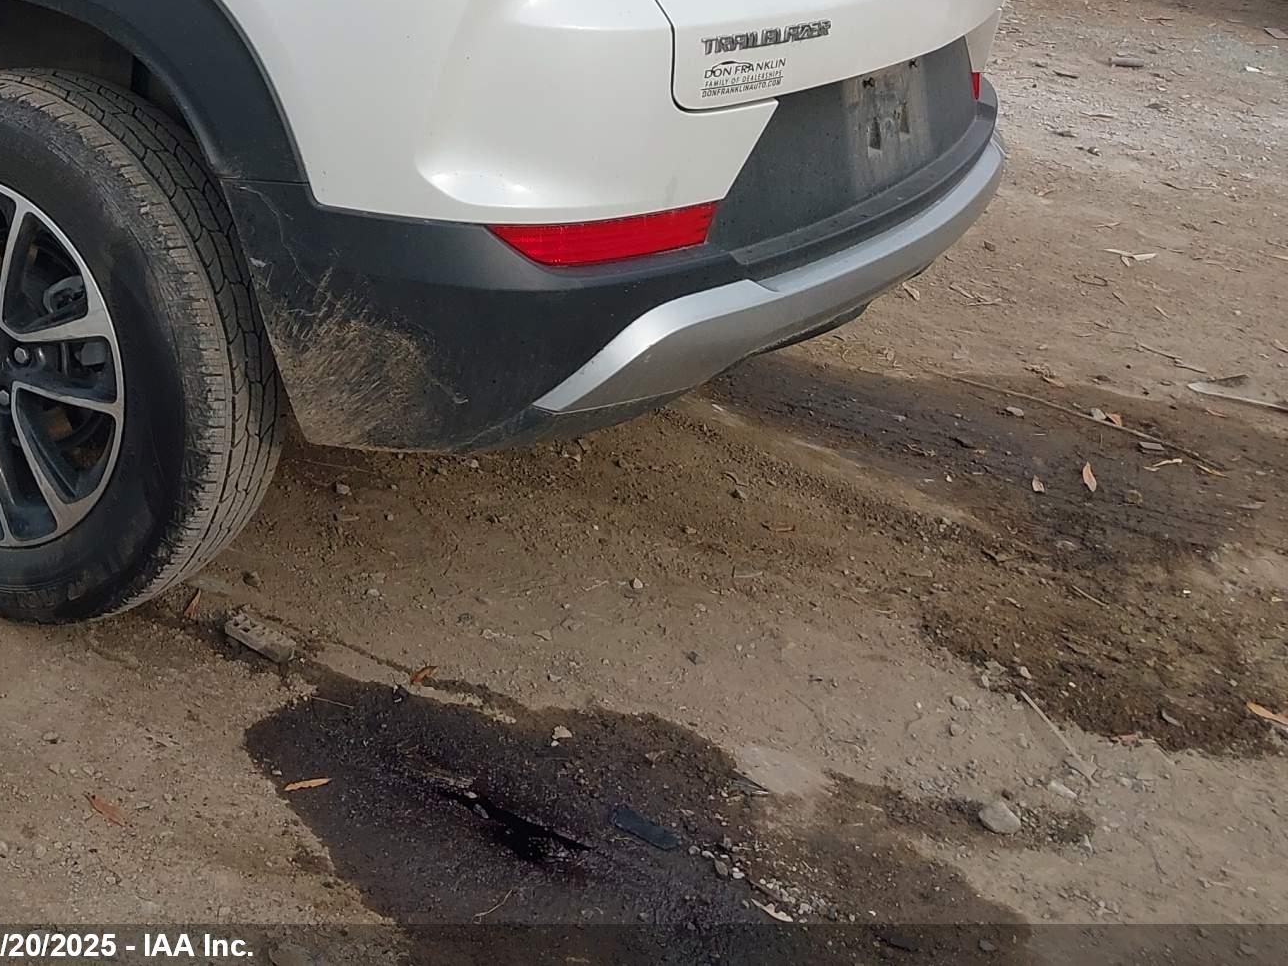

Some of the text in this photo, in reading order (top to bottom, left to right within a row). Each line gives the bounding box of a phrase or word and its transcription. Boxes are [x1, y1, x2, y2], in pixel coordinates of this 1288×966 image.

[701, 19, 832, 55] TRAILBLAZER
[704, 57, 787, 79] DON FRANKLIN
[704, 69, 783, 88] FAMILY OF DEALERSHIPS
[701, 77, 783, 98] DONFRANKLINAUTO.COM
